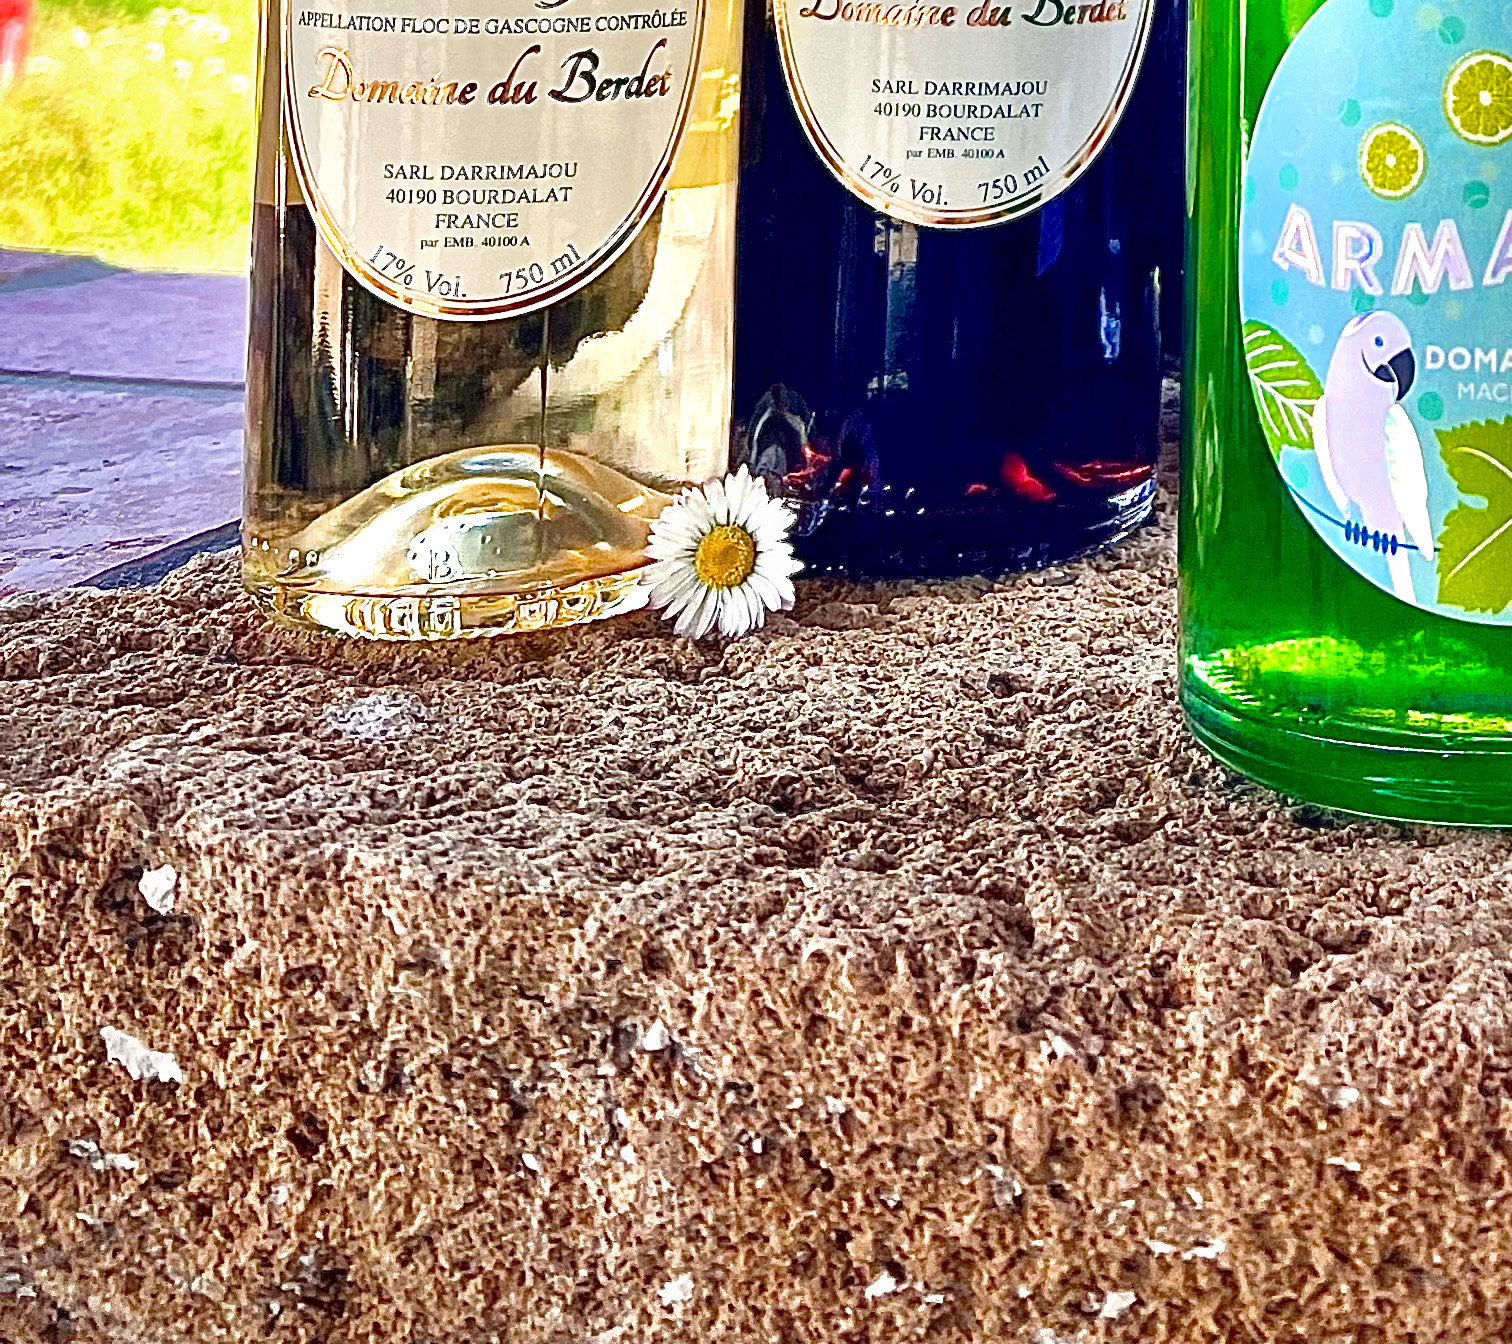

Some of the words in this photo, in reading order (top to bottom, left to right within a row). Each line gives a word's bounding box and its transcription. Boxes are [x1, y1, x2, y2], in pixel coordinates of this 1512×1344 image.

[298, 11, 396, 33] APPELLATION
[400, 17, 450, 34] FLOC
[453, 18, 480, 34] DE
[485, 17, 591, 35] GASCOGNE
[595, 7, 688, 32] CONTRÔLÉE
[307, 46, 482, 106] Domaine
[487, 43, 541, 106] du
[547, 37, 673, 104] Berdet
[871, 78, 918, 96] SARL
[924, 79, 1049, 97] DARRIMAJOU
[873, 102, 921, 118] 40190
[926, 102, 1044, 119] BOURDALAT
[918, 125, 996, 142] FRANCE
[996, 148, 1005, 159] A
[384, 163, 434, 181] SARL
[440, 162, 578, 181] DARRIMAJOU
[858, 154, 901, 194] 17%
[910, 178, 948, 206] Vol.
[977, 173, 1018, 203] 750
[1023, 155, 1051, 186] ml
[385, 188, 437, 205] 40190
[443, 186, 573, 205] BOURDALAT
[434, 212, 519, 229] FRANCE
[481, 236, 518, 248] 40100
[519, 236, 530, 247] A
[369, 244, 416, 286] 17%
[424, 269, 467, 298] Vol.
[499, 262, 544, 294] 750
[550, 242, 582, 276] ml
